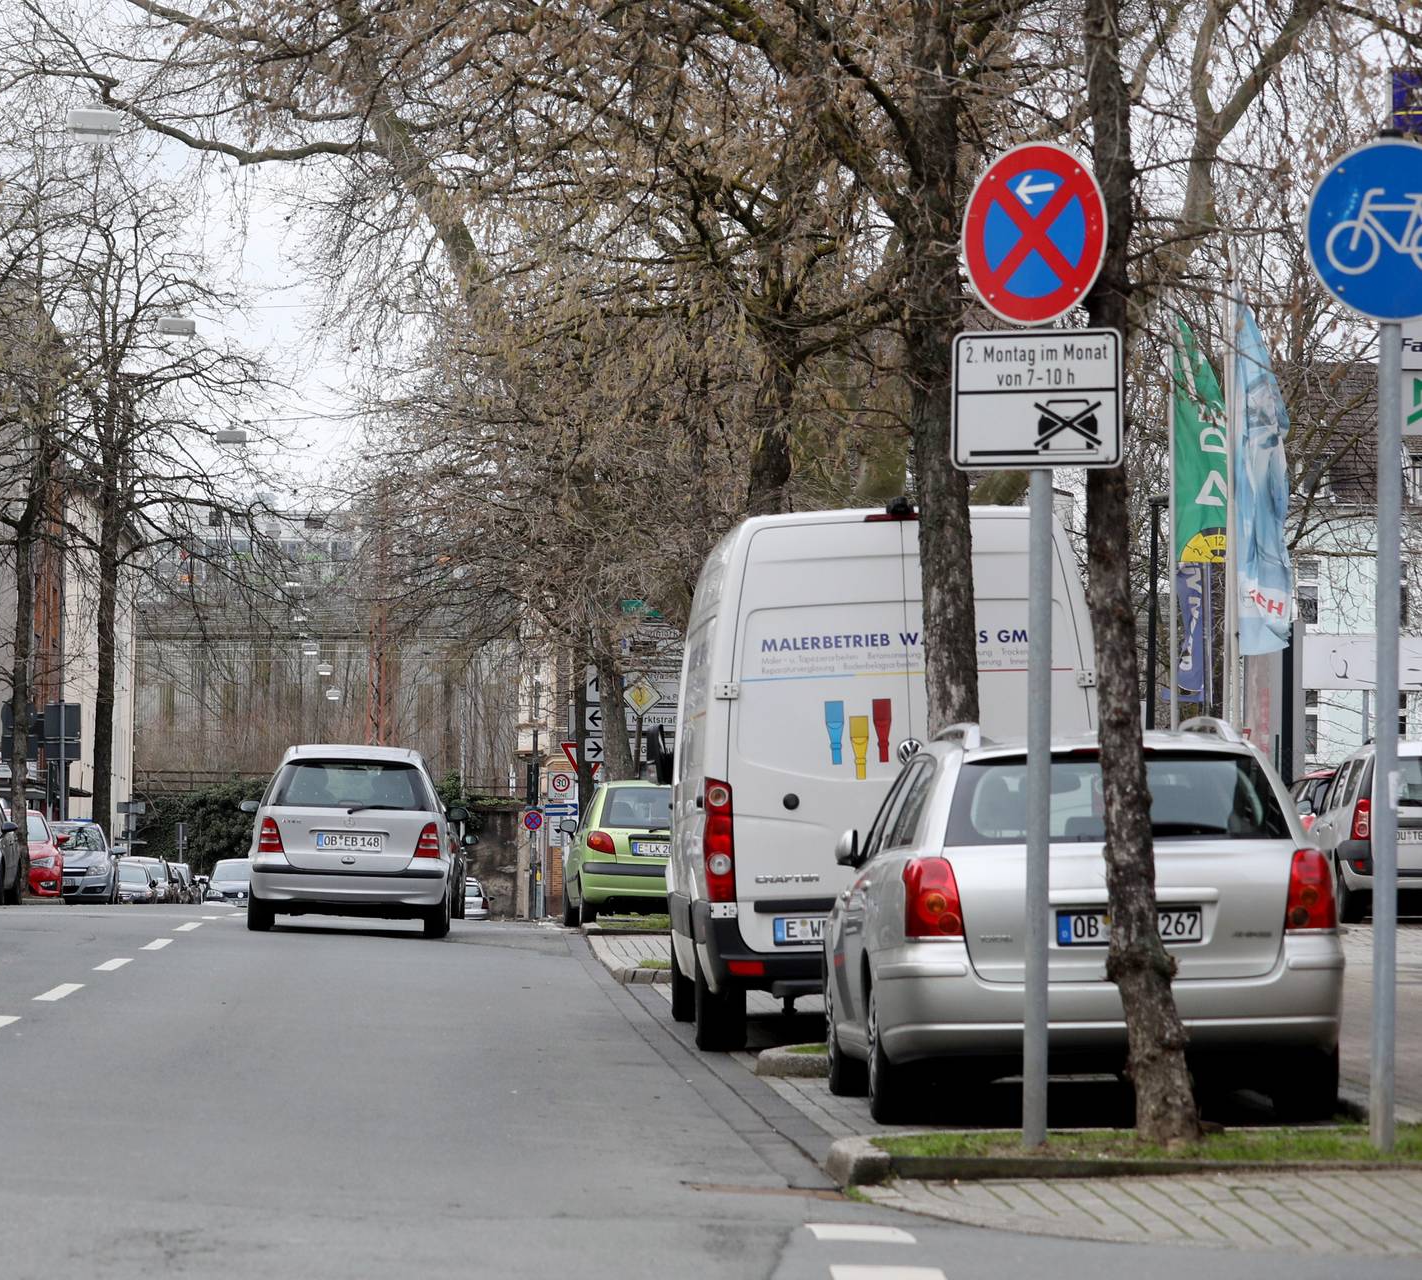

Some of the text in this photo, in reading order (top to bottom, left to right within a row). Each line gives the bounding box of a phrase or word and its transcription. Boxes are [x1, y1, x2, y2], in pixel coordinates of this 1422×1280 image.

[966, 343, 1108, 366] 2. Montag im Monat
[997, 374, 1022, 386] von
[1067, 368, 1075, 385] h
[761, 633, 891, 653] MALERBETRIEB
[556, 778, 567, 788] 30
[324, 835, 380, 848] OB EB 148
[638, 844, 644, 852] E
[755, 874, 820, 883] CRAFTER
[785, 921, 798, 938] E
[1073, 914, 1199, 938] OB 267
